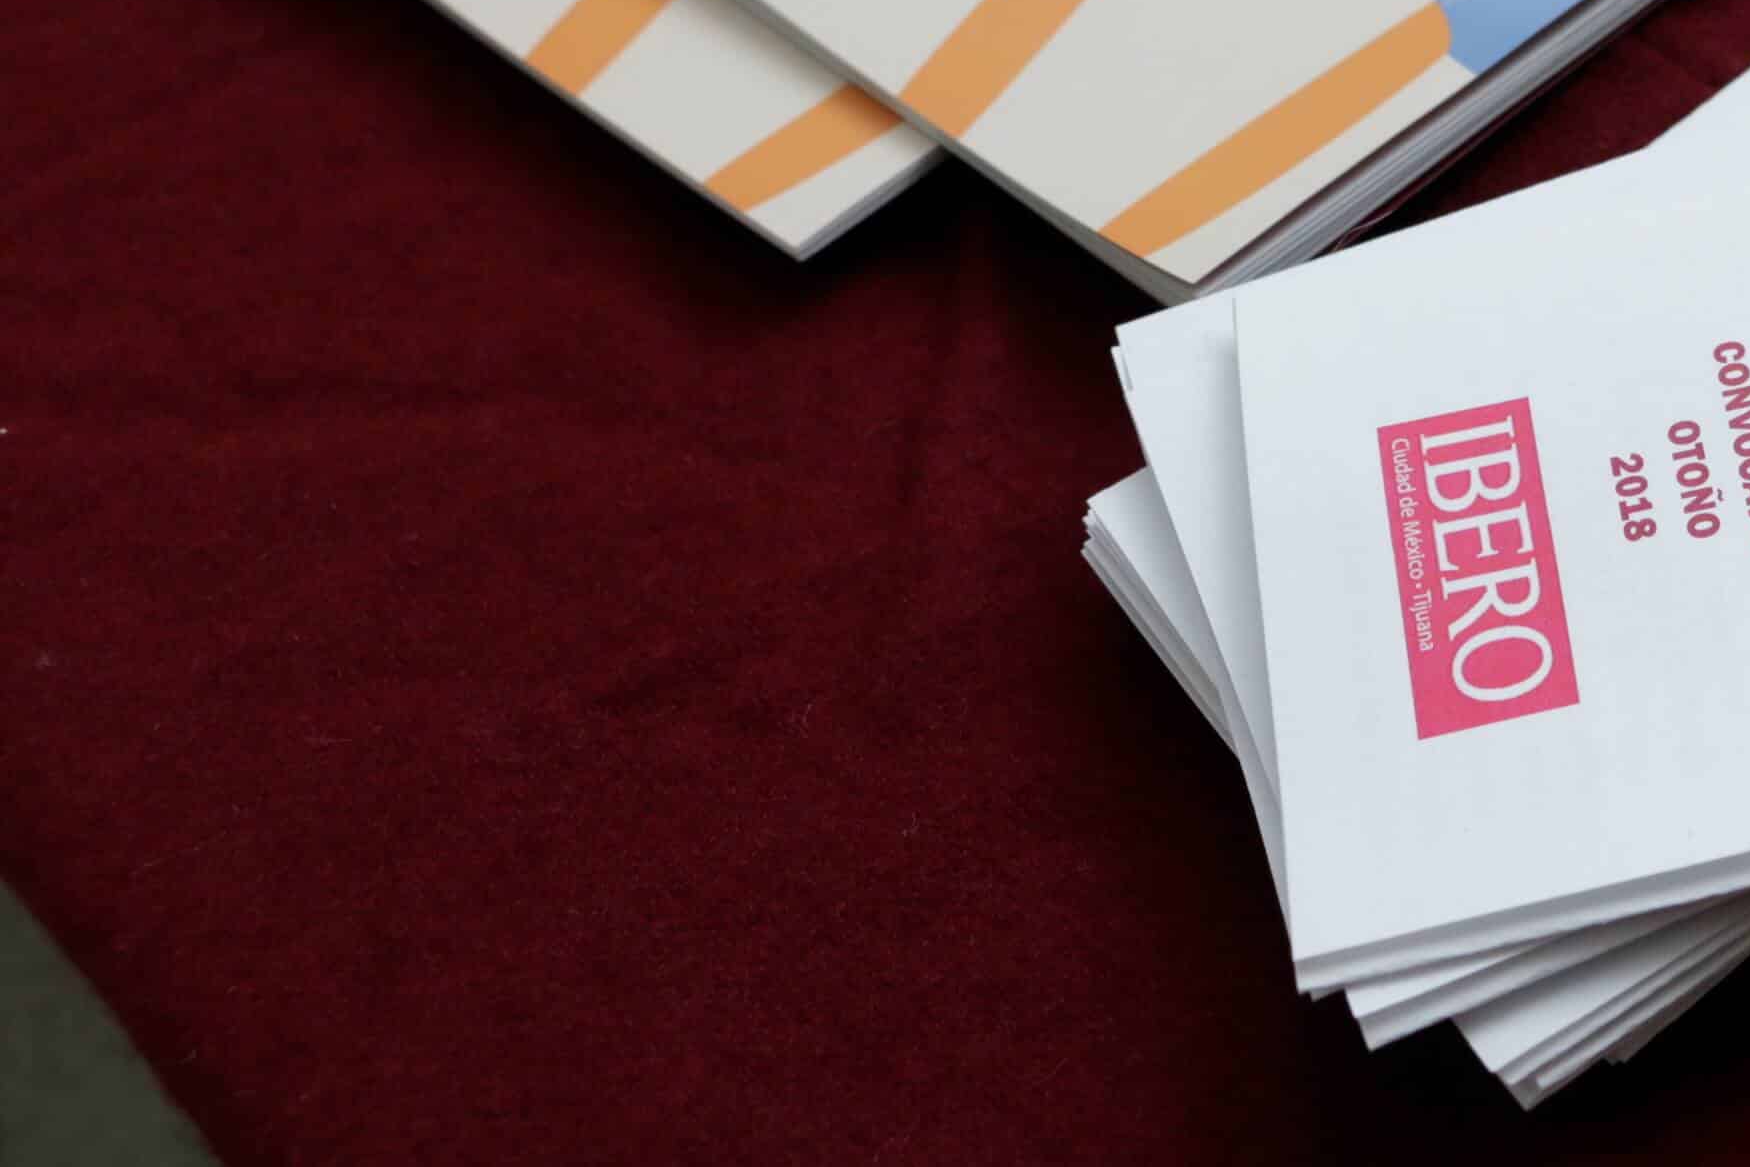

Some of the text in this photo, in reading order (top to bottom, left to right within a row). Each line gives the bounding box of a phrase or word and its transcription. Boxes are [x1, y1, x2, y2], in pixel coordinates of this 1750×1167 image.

[1391, 437, 1434, 651] Ciudad de México Tijuana
[1420, 415, 1554, 702] IBERO
[1610, 452, 1657, 542] 2018
[1667, 420, 1725, 539] OTOÑO
